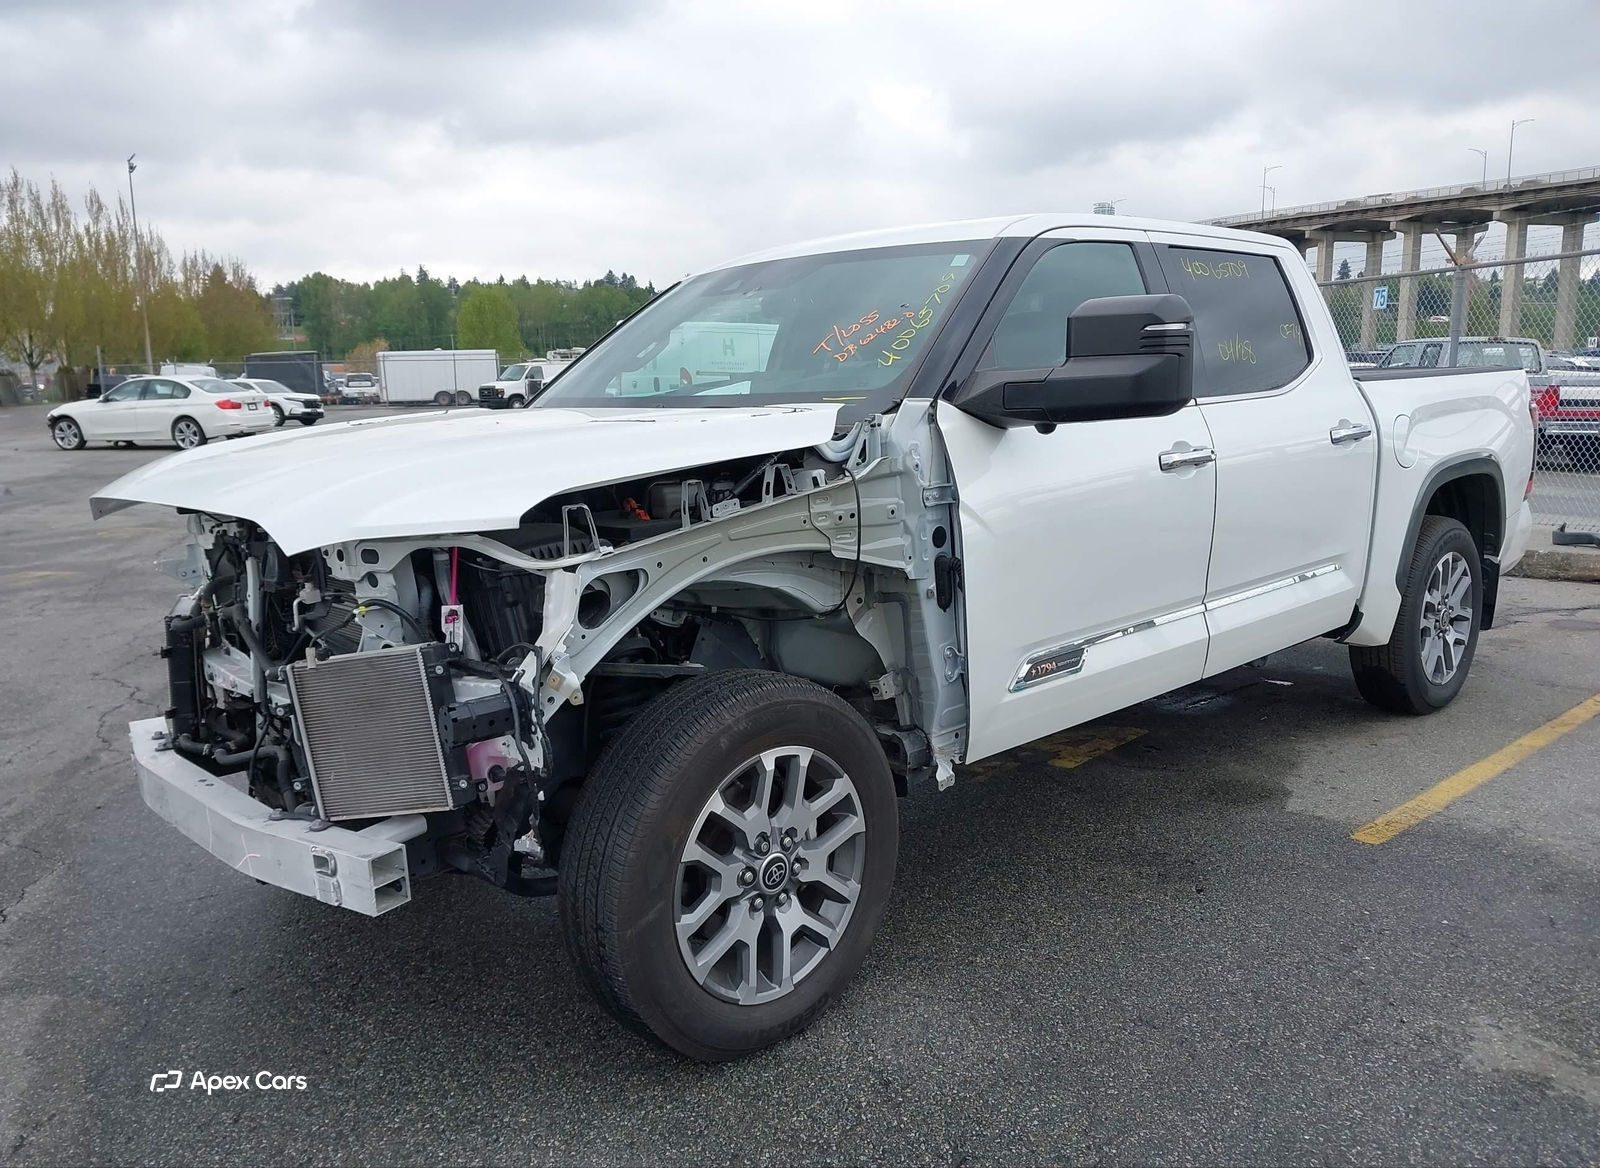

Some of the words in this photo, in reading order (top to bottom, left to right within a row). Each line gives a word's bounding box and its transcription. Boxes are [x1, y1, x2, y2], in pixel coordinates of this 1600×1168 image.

[1180, 257, 1250, 281] 40065709
[1375, 288, 1386, 307] 75
[813, 309, 880, 354] T/LOSS
[1036, 661, 1057, 675] 1794
